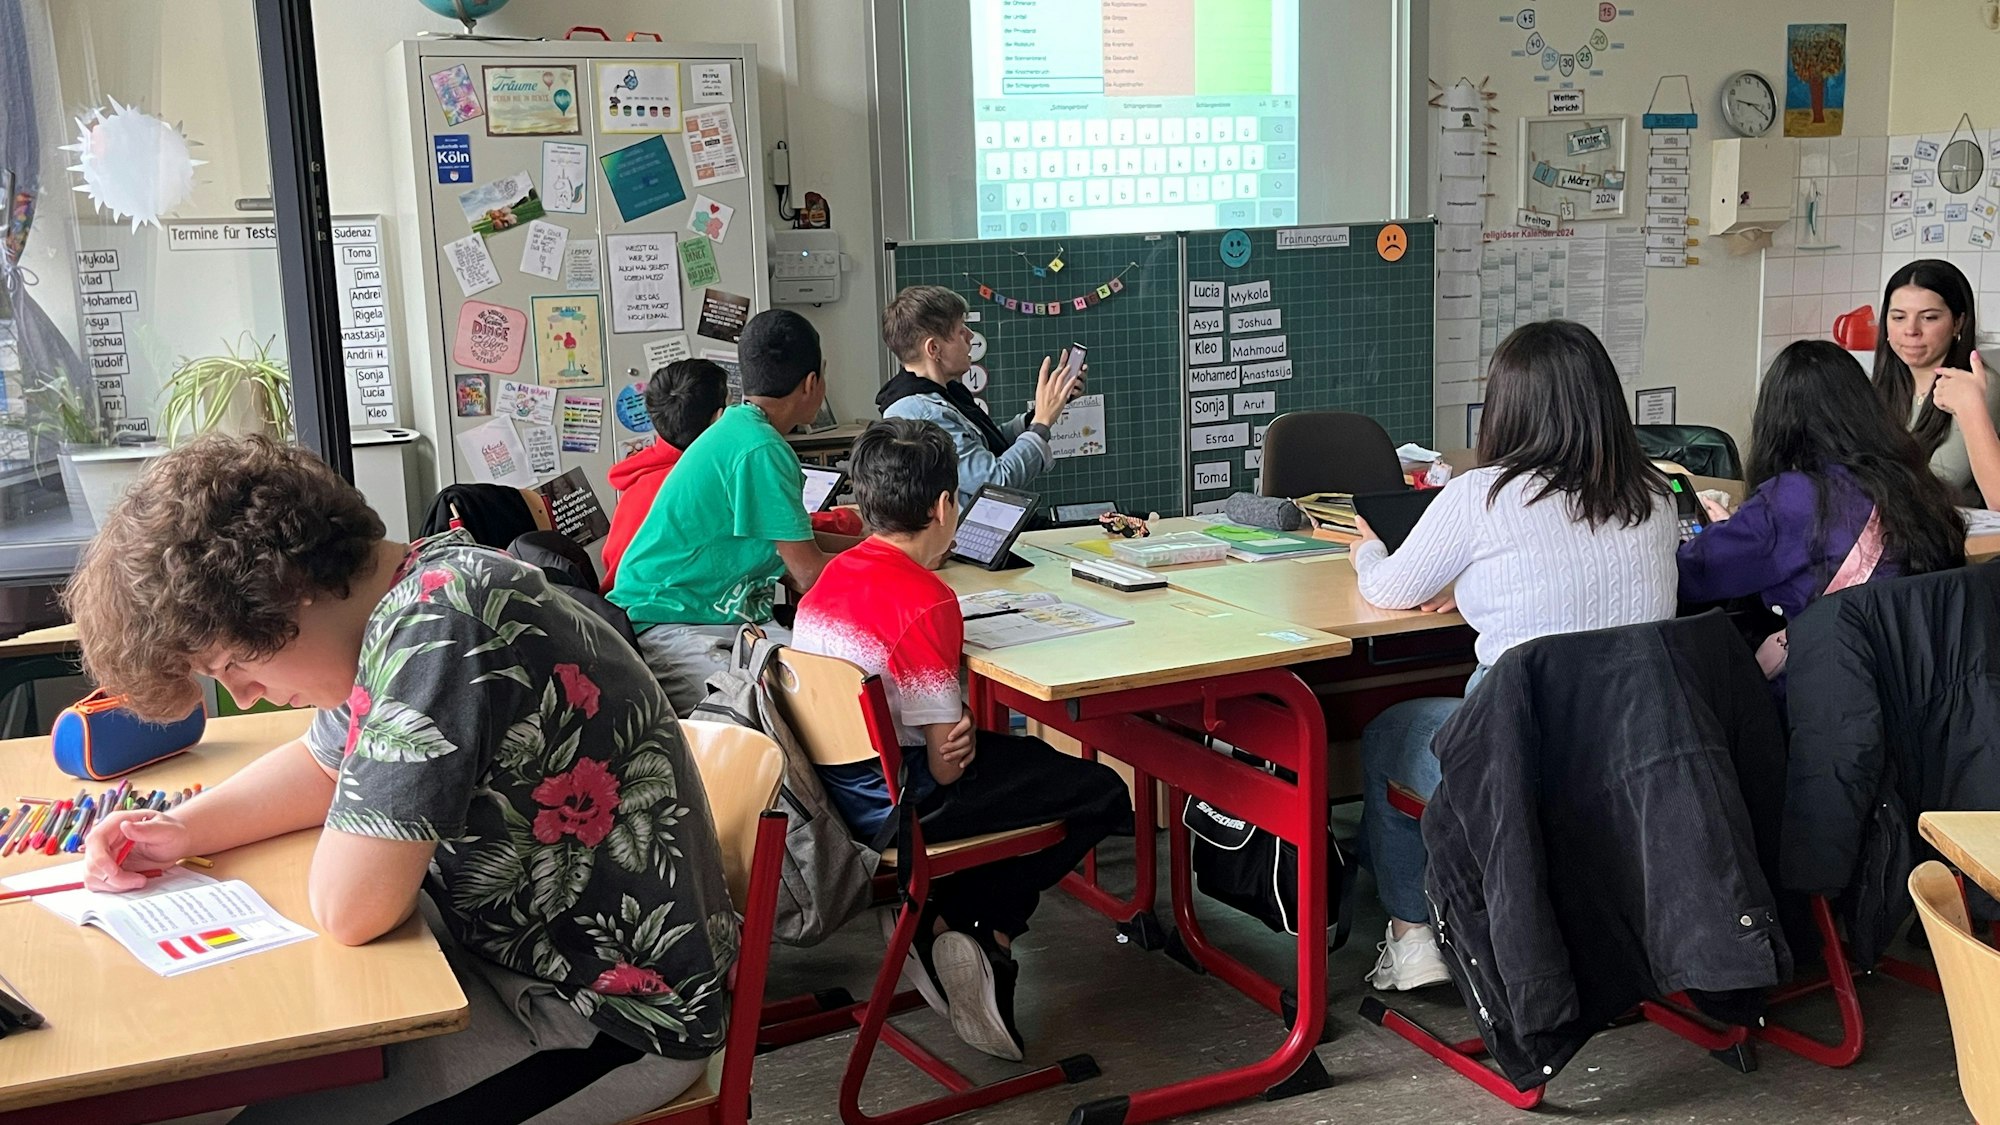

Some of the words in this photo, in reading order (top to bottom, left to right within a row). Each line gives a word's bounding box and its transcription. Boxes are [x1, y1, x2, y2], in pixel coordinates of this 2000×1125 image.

[492, 75, 538, 91] Träume
[1577, 134, 1600, 146] Winter
[437, 150, 470, 164] Köln
[1567, 174, 1590, 187] März
[1595, 193, 1616, 204] 2024
[1562, 206, 1571, 216] 15
[171, 227, 219, 240] Termine
[223, 225, 241, 239] für
[245, 226, 276, 239] Tests
[334, 226, 371, 239] Sudenaz
[1278, 231, 1348, 246] Trainingsraum
[1521, 228, 1553, 238] Kalender
[1556, 228, 1574, 237] 2024
[347, 248, 372, 258] Toma
[78, 252, 115, 268] Mykola
[79, 273, 103, 286] Vlad
[356, 269, 380, 281] Dima
[82, 293, 132, 307] Mohamed
[352, 288, 381, 300] Andrei
[1193, 284, 1220, 298] Lucia
[1230, 287, 1269, 304] Mykola
[355, 308, 383, 323] Rigela
[84, 317, 110, 331] Asya
[1193, 319, 1219, 331] Asya
[1237, 317, 1273, 329] Joshua
[87, 335, 123, 348] Joshua
[1195, 341, 1217, 354] Kleo
[1232, 342, 1284, 358] Mahmoud
[90, 354, 124, 368] Rudolf
[358, 369, 384, 383] Sonja
[1191, 368, 1238, 383] Mohamed
[1242, 366, 1292, 381] Anastasija
[96, 379, 121, 390] sraa
[362, 388, 385, 398] Lucia
[105, 400, 122, 410] rut
[1194, 397, 1225, 417] Sonja
[1243, 399, 1265, 410] Arut
[368, 407, 387, 418] Kleo
[115, 419, 147, 432] moud
[1205, 433, 1234, 445] Esraa
[1197, 472, 1228, 485] Toma
[565, 506, 598, 526] Menschen
[1196, 801, 1246, 831] SKECHERS
